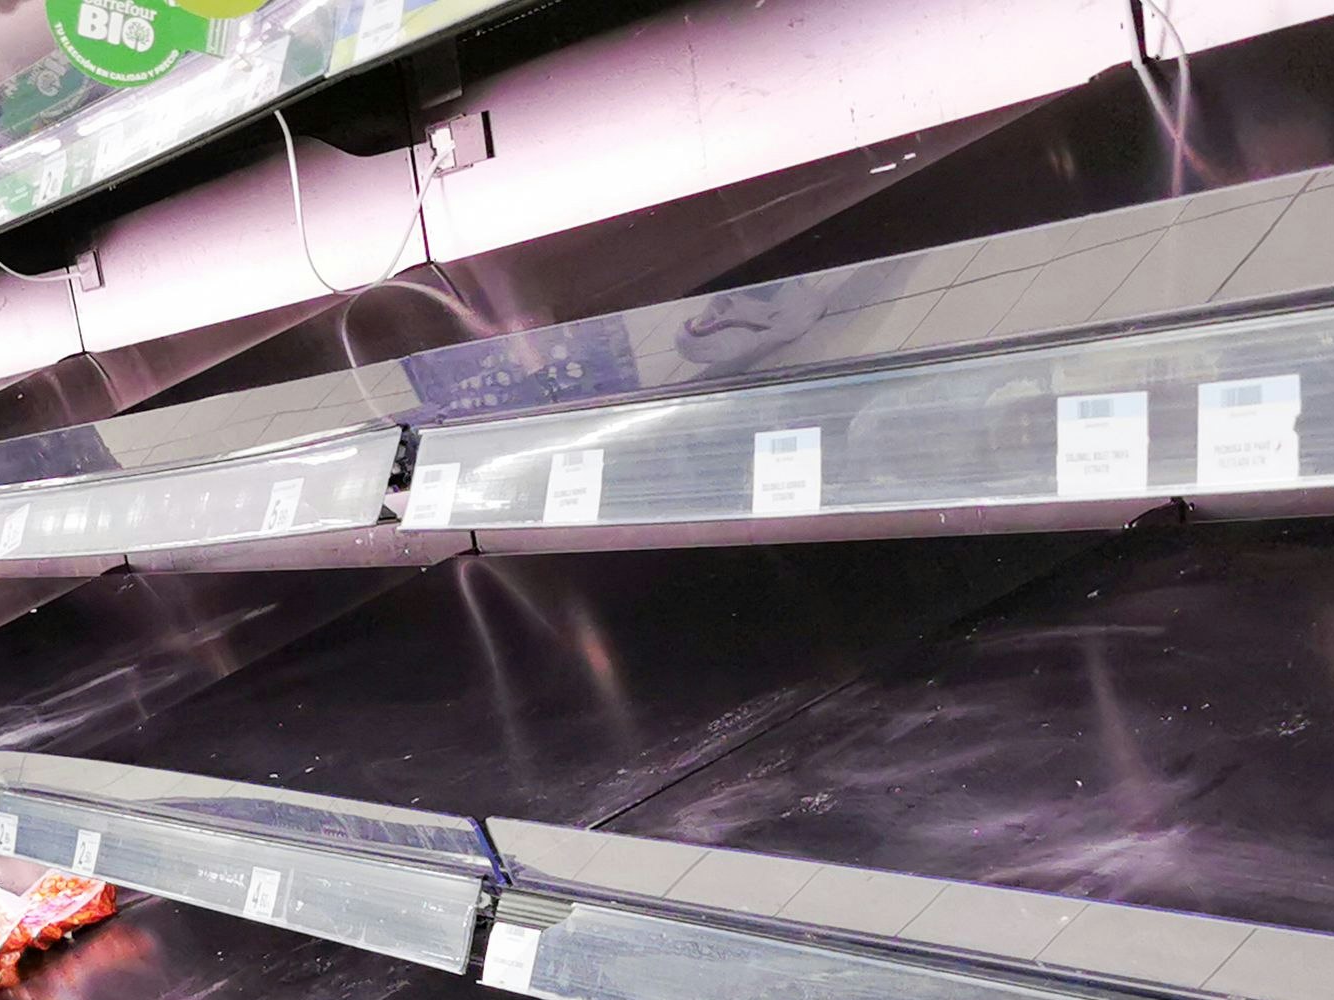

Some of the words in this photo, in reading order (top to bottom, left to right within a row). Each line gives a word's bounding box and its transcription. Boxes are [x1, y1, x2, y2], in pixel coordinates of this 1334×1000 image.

[83, 0, 158, 21] arrefour
[77, 3, 155, 53] BIO
[110, 72, 148, 82] CALIDAD
